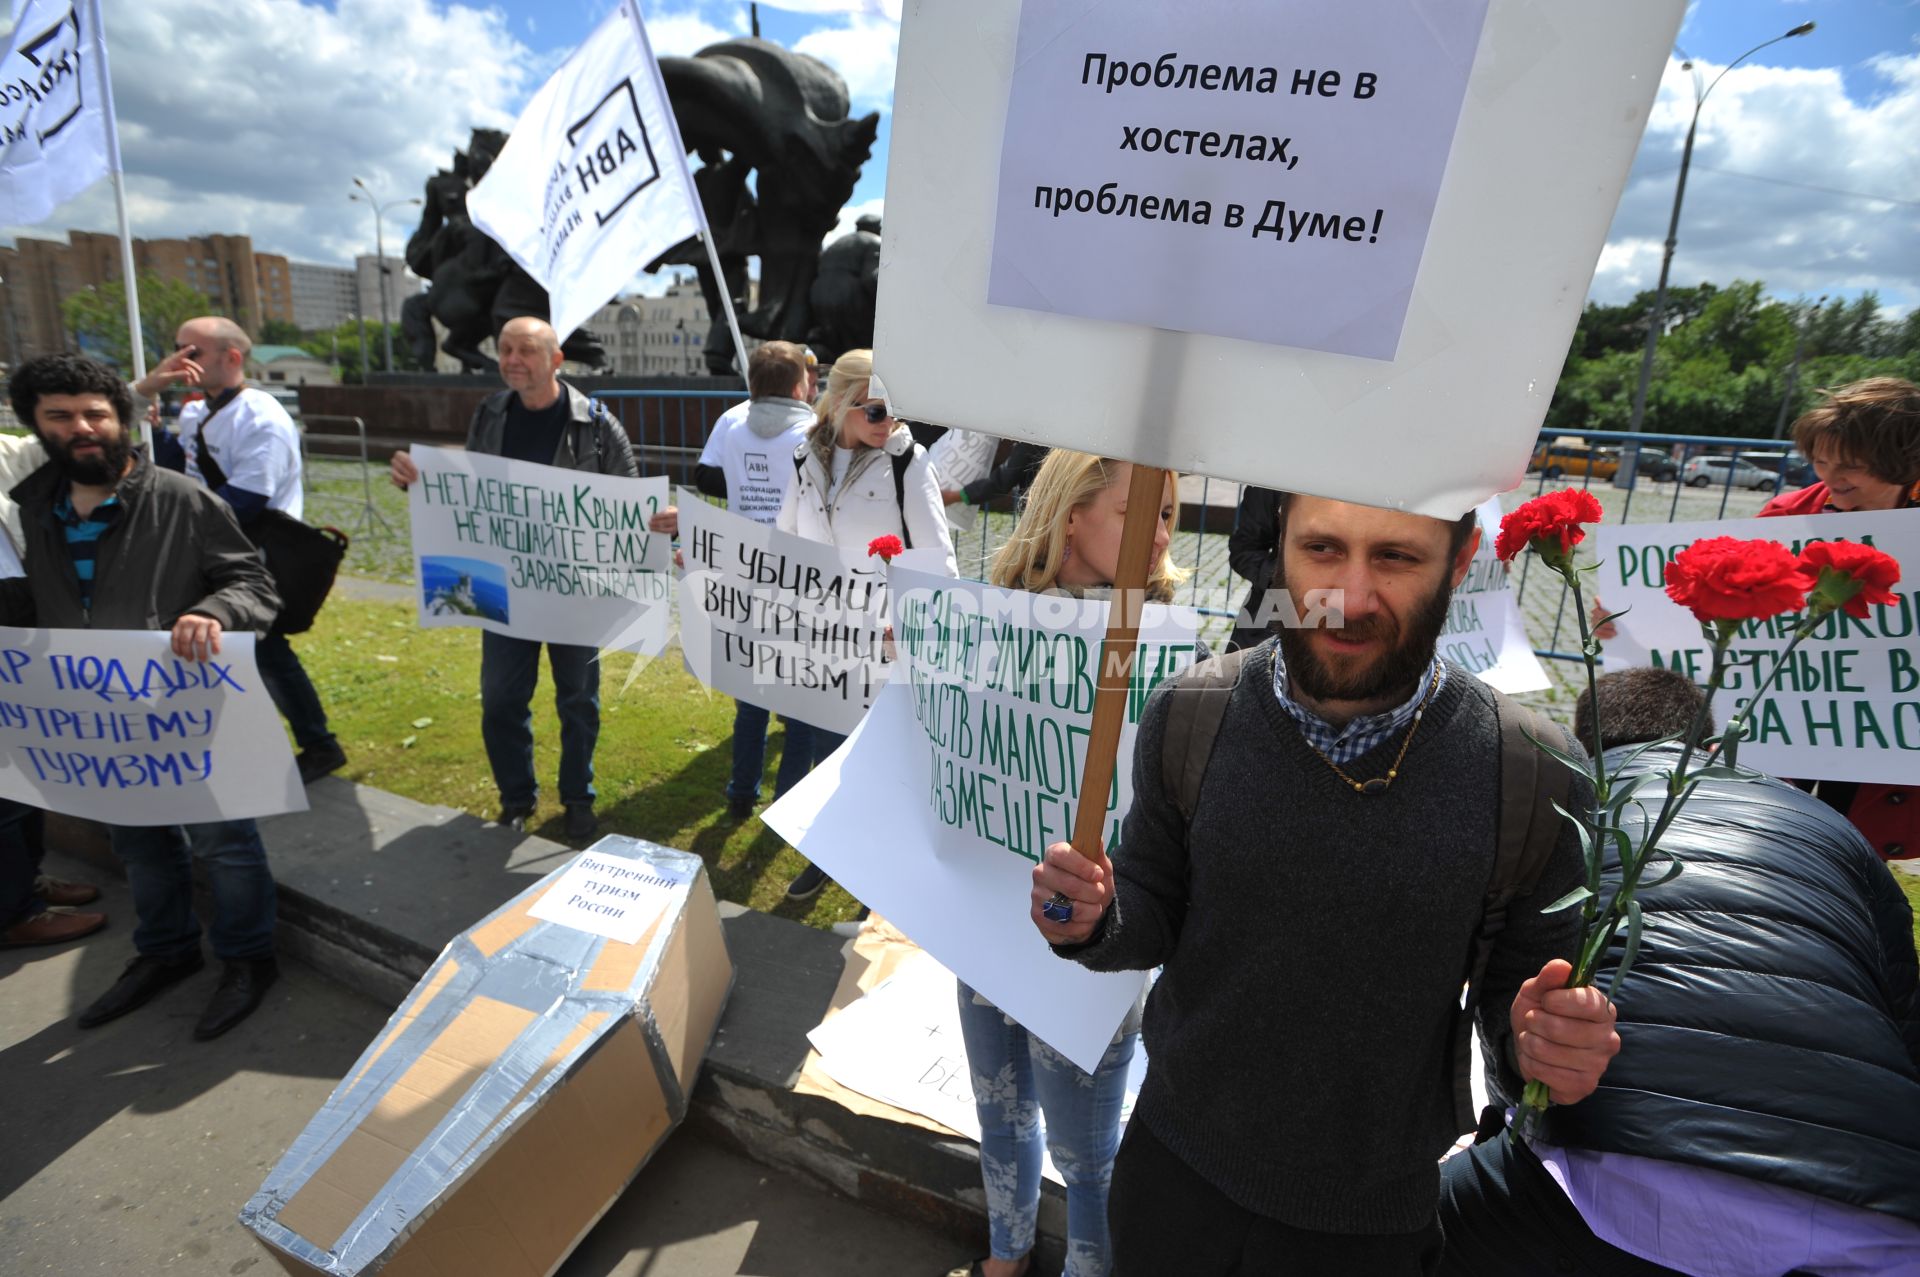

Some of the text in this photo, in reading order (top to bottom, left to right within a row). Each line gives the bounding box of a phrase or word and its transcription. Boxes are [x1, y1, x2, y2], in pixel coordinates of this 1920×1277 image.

[1081, 53, 1378, 99] Проблема не в
[1119, 125, 1299, 171] хостелах,
[1034, 182, 1384, 244] проблема в Думе!
[748, 462, 769, 473] АВН
[421, 471, 470, 506] НЕТ
[474, 478, 539, 517] ДЕНЕГ
[541, 489, 571, 526] НА
[454, 510, 651, 565] НЕ МЕШАЙТЕ ЕМУ
[692, 525, 724, 570] НЕ
[18, 746, 212, 788] ТУРИЗМУ
[578, 858, 678, 890] Внутренний
[584, 879, 641, 902] туризм
[568, 894, 626, 919] России
